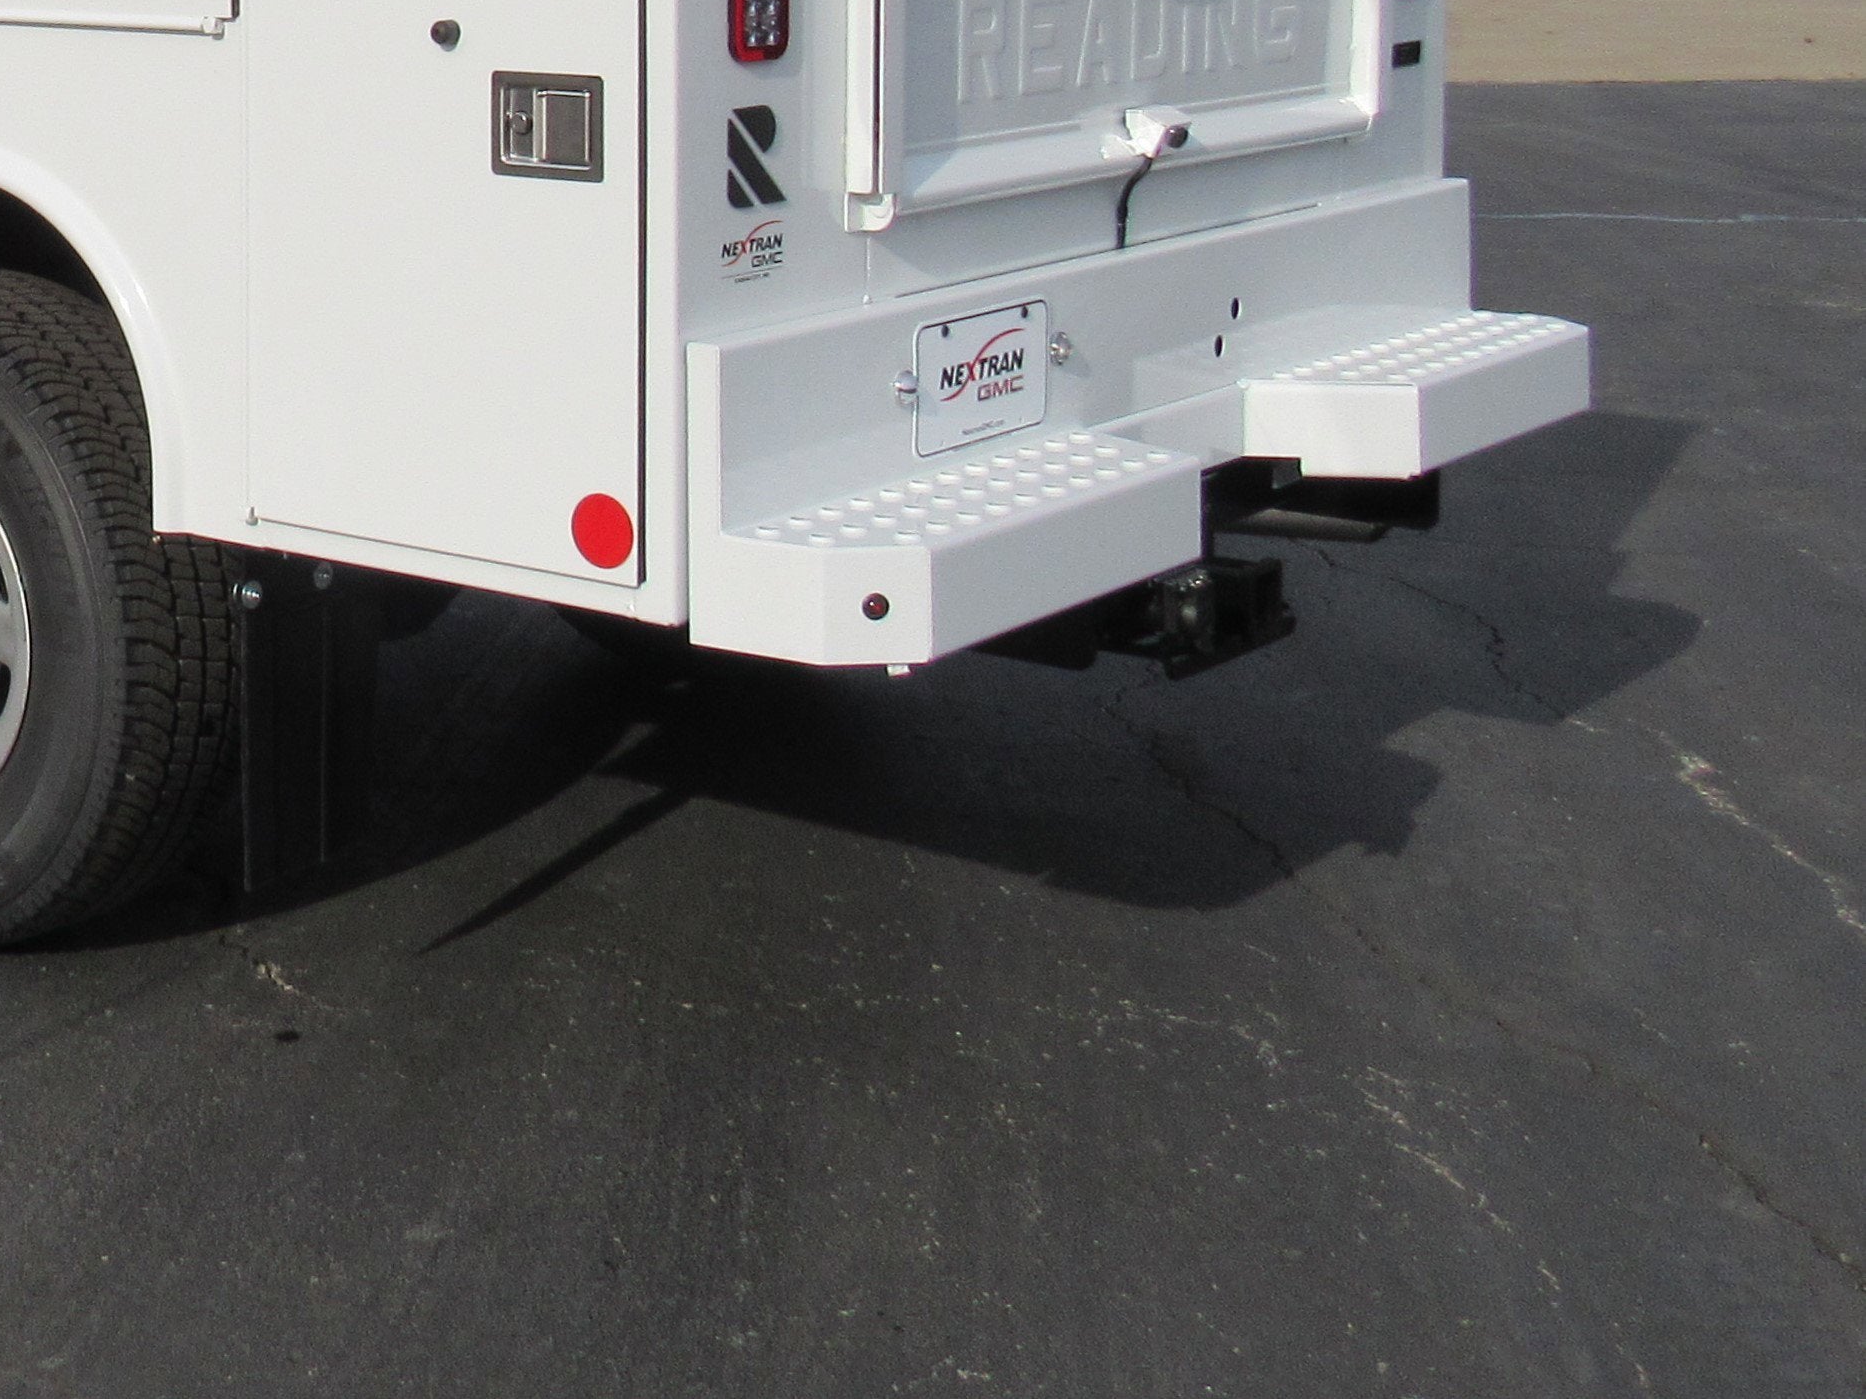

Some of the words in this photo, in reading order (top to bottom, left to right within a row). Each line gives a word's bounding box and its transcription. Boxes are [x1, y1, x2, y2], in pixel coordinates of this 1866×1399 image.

[721, 233, 783, 258] NEXTRAN
[751, 252, 783, 268] GMC
[939, 348, 1024, 390] NEXTRAN
[977, 375, 1023, 401] GMC
